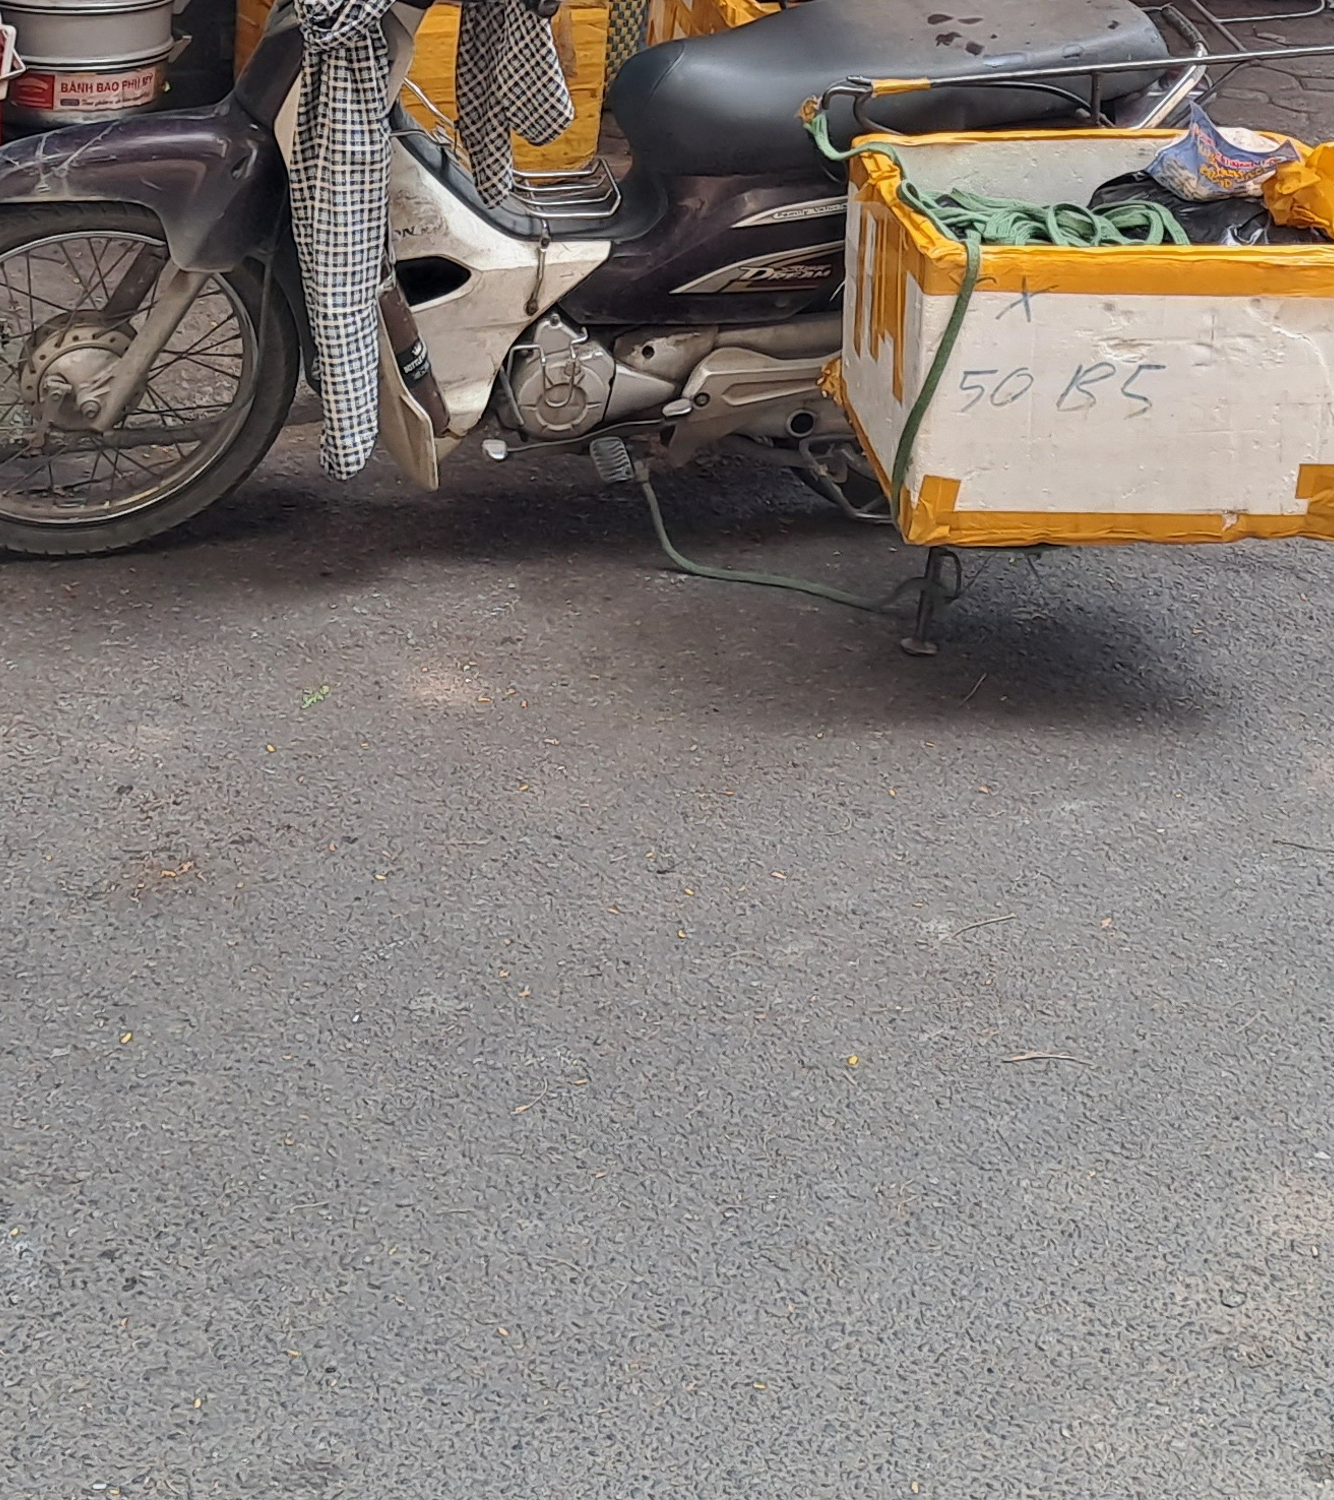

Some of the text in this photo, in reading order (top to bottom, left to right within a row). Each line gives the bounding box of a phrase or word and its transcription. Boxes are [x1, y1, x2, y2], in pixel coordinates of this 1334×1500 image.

[60, 78, 94, 94] BÁNH
[96, 81, 119, 93] BAO
[960, 367, 1035, 413] 50
